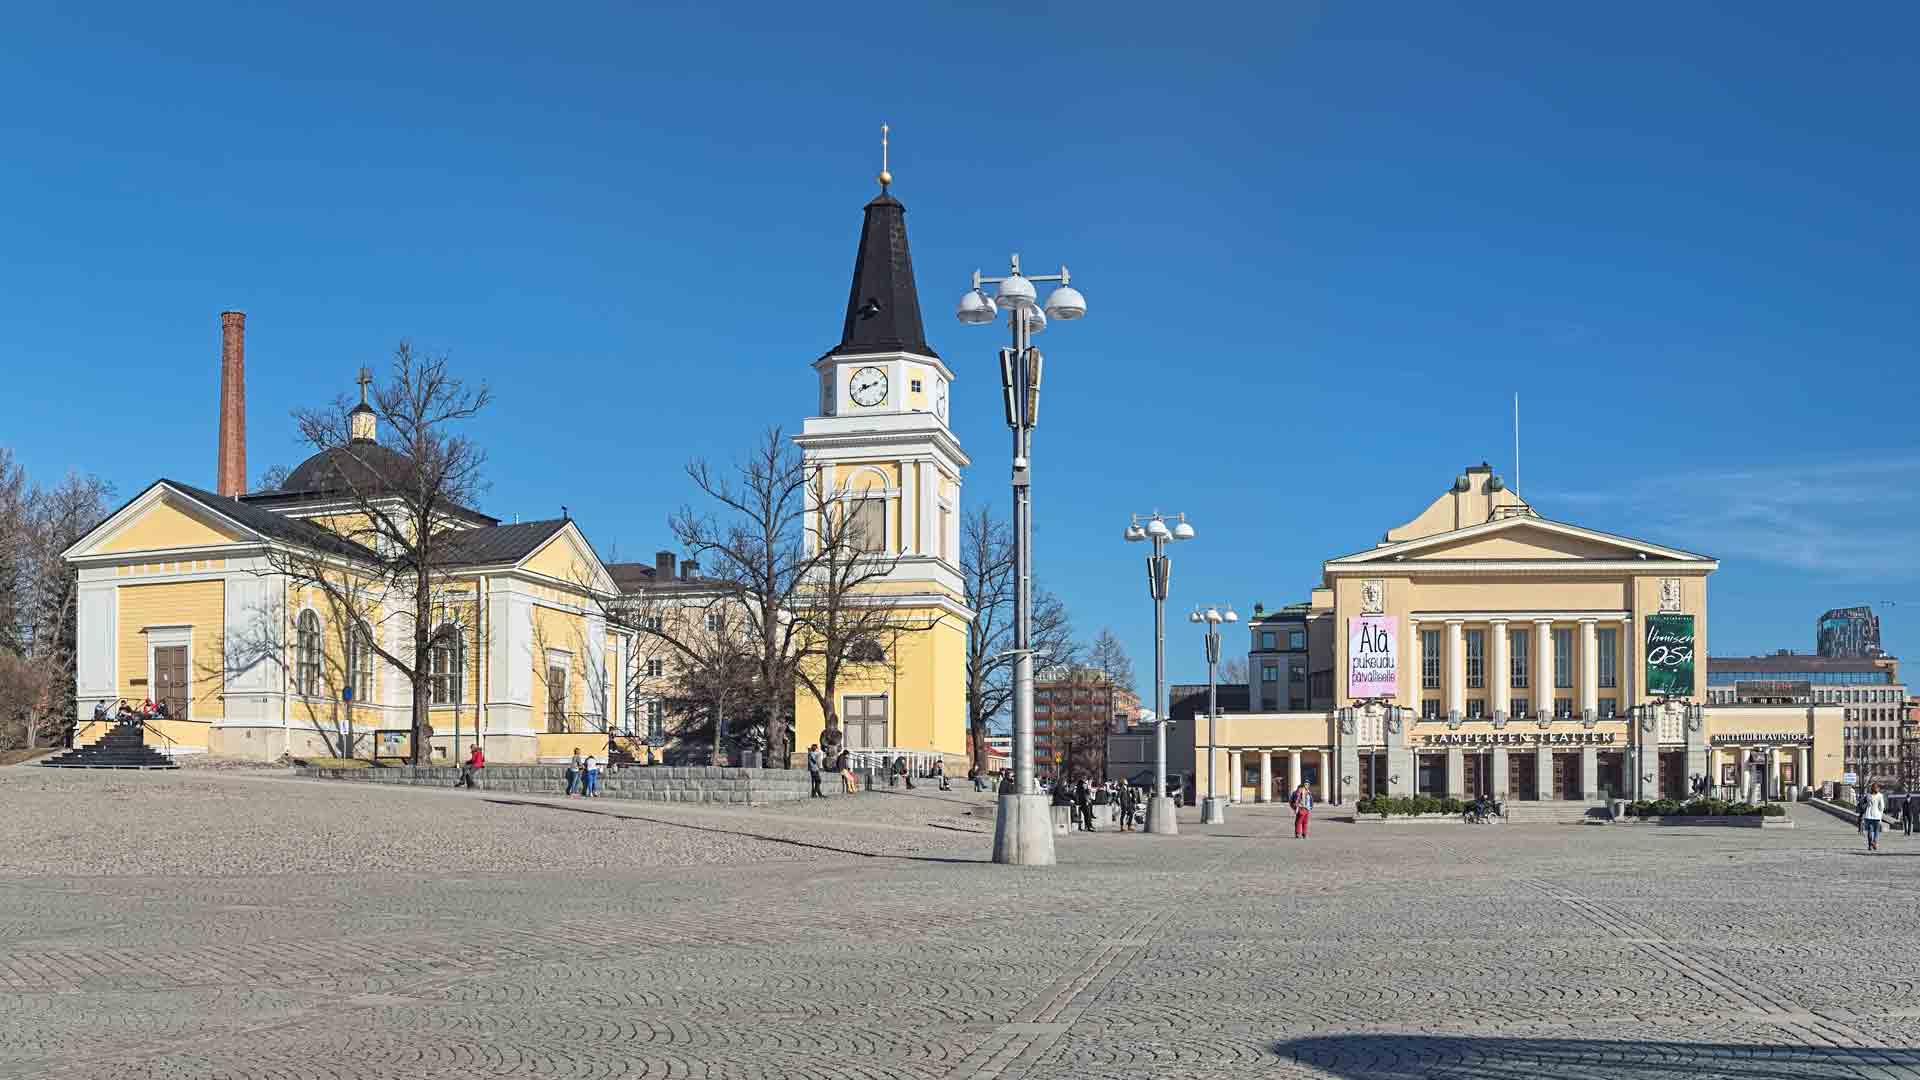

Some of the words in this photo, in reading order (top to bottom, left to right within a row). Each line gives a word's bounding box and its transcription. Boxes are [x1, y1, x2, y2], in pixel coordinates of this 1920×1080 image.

[1360, 622, 1390, 653] Älä
[1352, 653, 1395, 674] pukeudu
[1428, 732, 1531, 743] TAMPEREEN
[1537, 732, 1617, 742] TEATTERI
[1713, 733, 1809, 742] KULTTUURIRAVINTOLA
